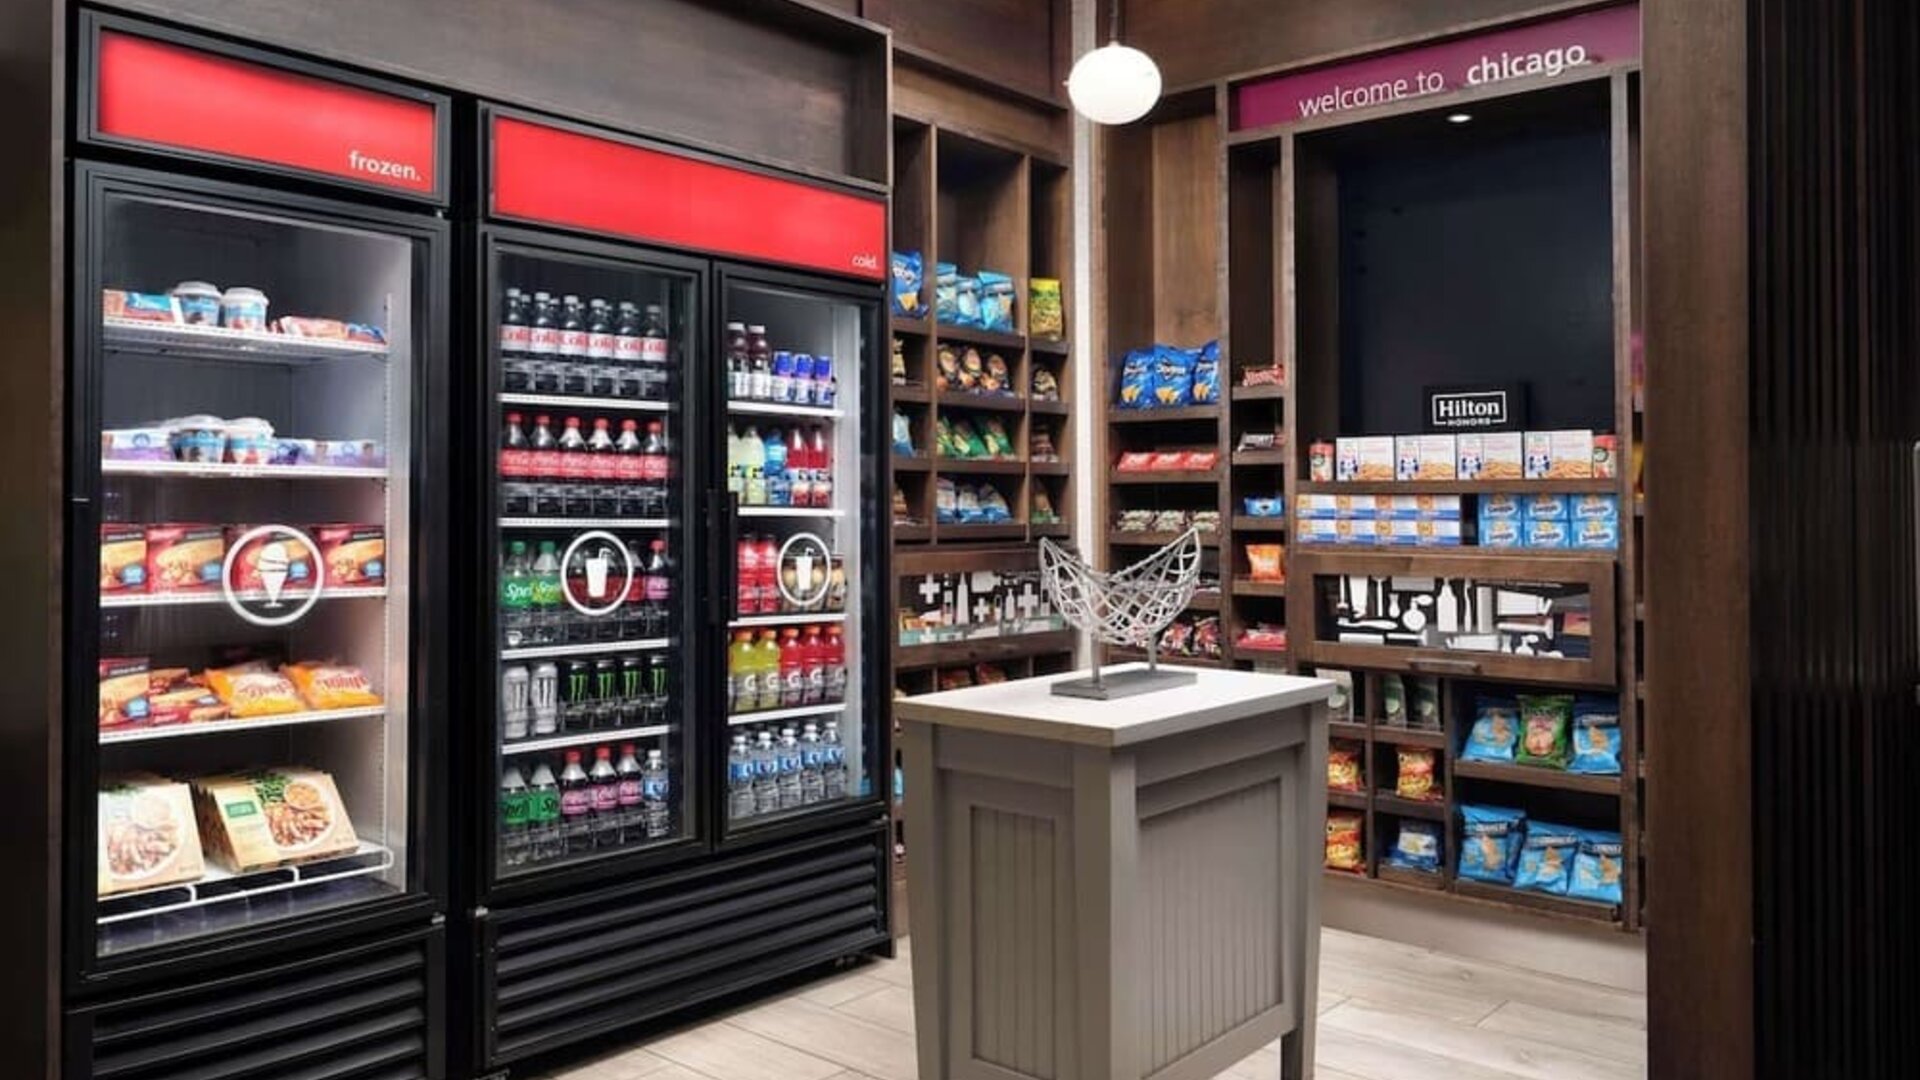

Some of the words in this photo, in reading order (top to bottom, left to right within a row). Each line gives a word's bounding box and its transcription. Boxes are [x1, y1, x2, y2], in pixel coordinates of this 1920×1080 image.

[1299, 79, 1408, 117] welcome
[1415, 71, 1444, 95] to
[348, 150, 421, 181] frozen.
[1439, 400, 1500, 417] Hilton
